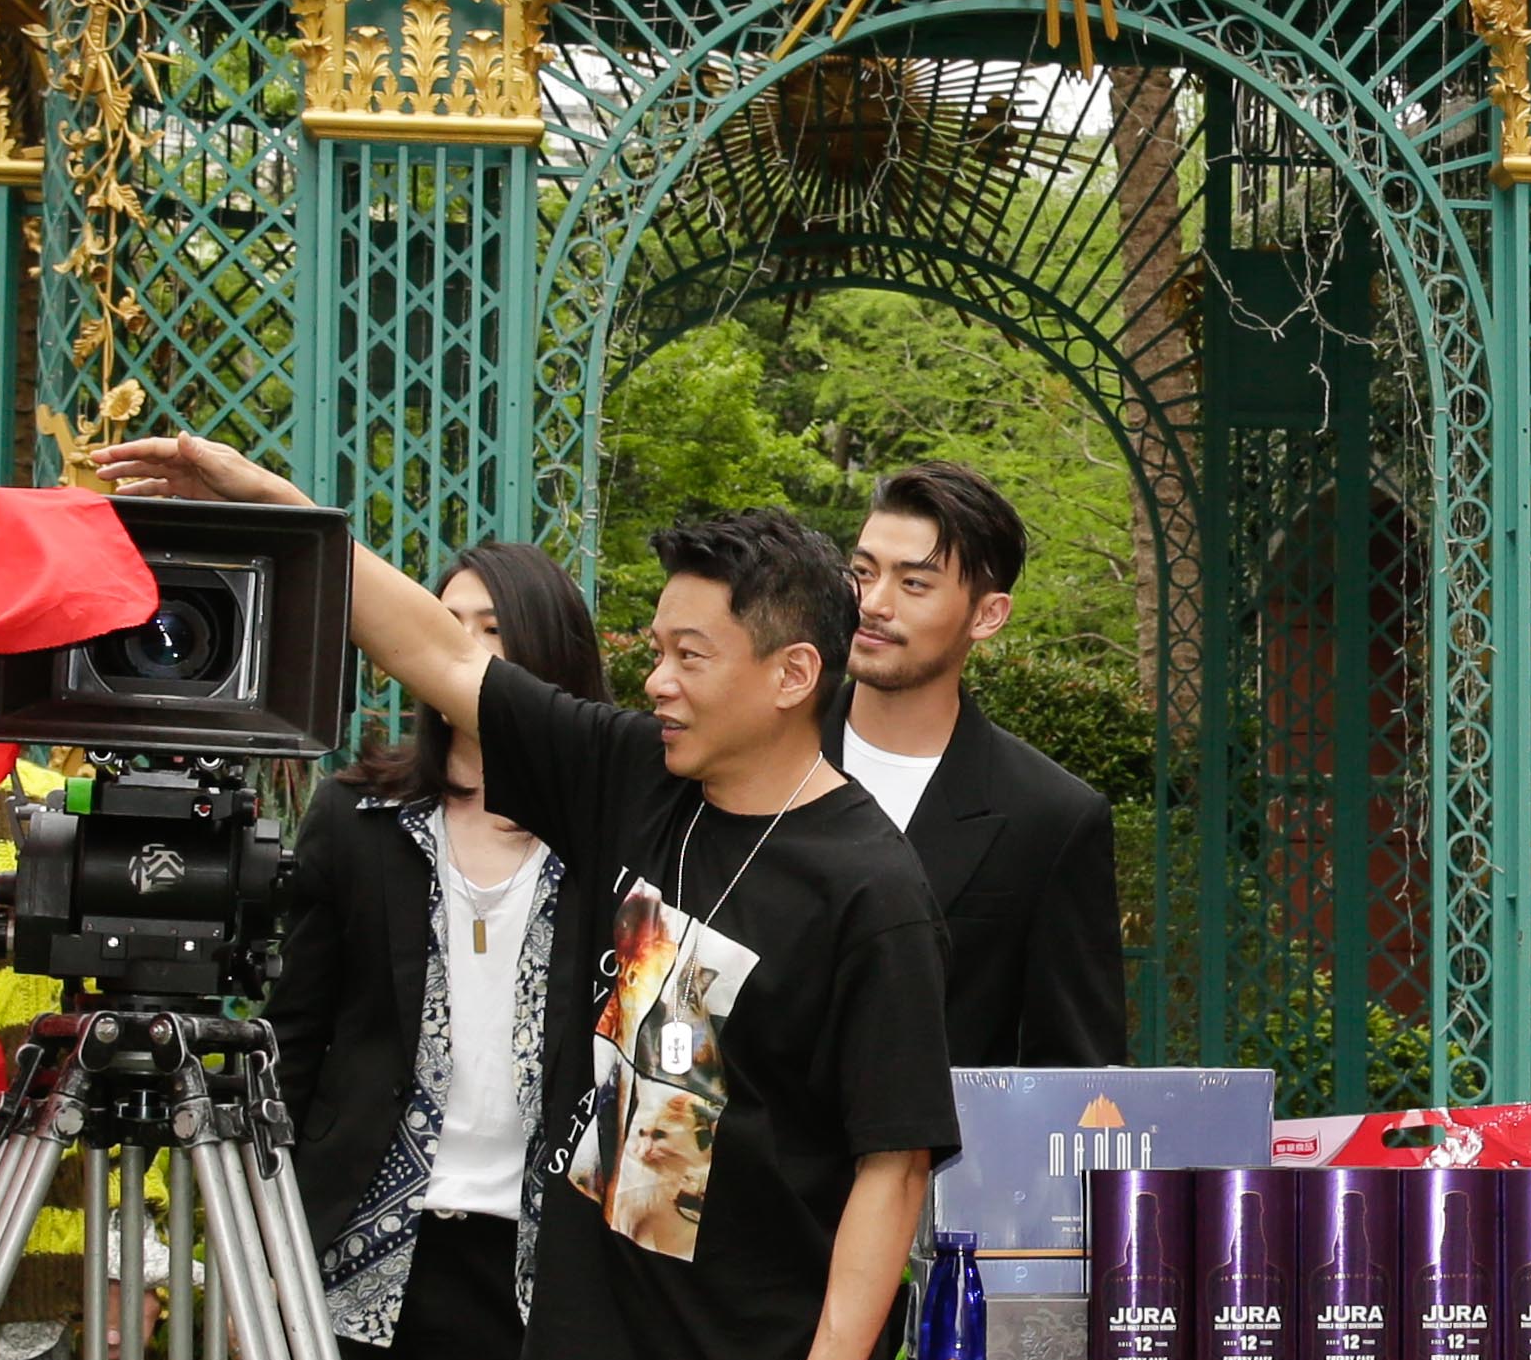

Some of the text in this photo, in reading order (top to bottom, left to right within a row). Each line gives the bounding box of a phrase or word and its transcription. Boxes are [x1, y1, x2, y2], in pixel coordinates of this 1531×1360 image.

[1109, 1307, 1176, 1324] JURA
[1213, 1306, 1281, 1323] JURA
[1316, 1305, 1384, 1323] JURA
[1421, 1304, 1488, 1321] JURA
[1134, 1336, 1153, 1352] 12
[1239, 1335, 1257, 1351] 12
[1341, 1334, 1360, 1350] 12
[1446, 1333, 1465, 1349] 12
